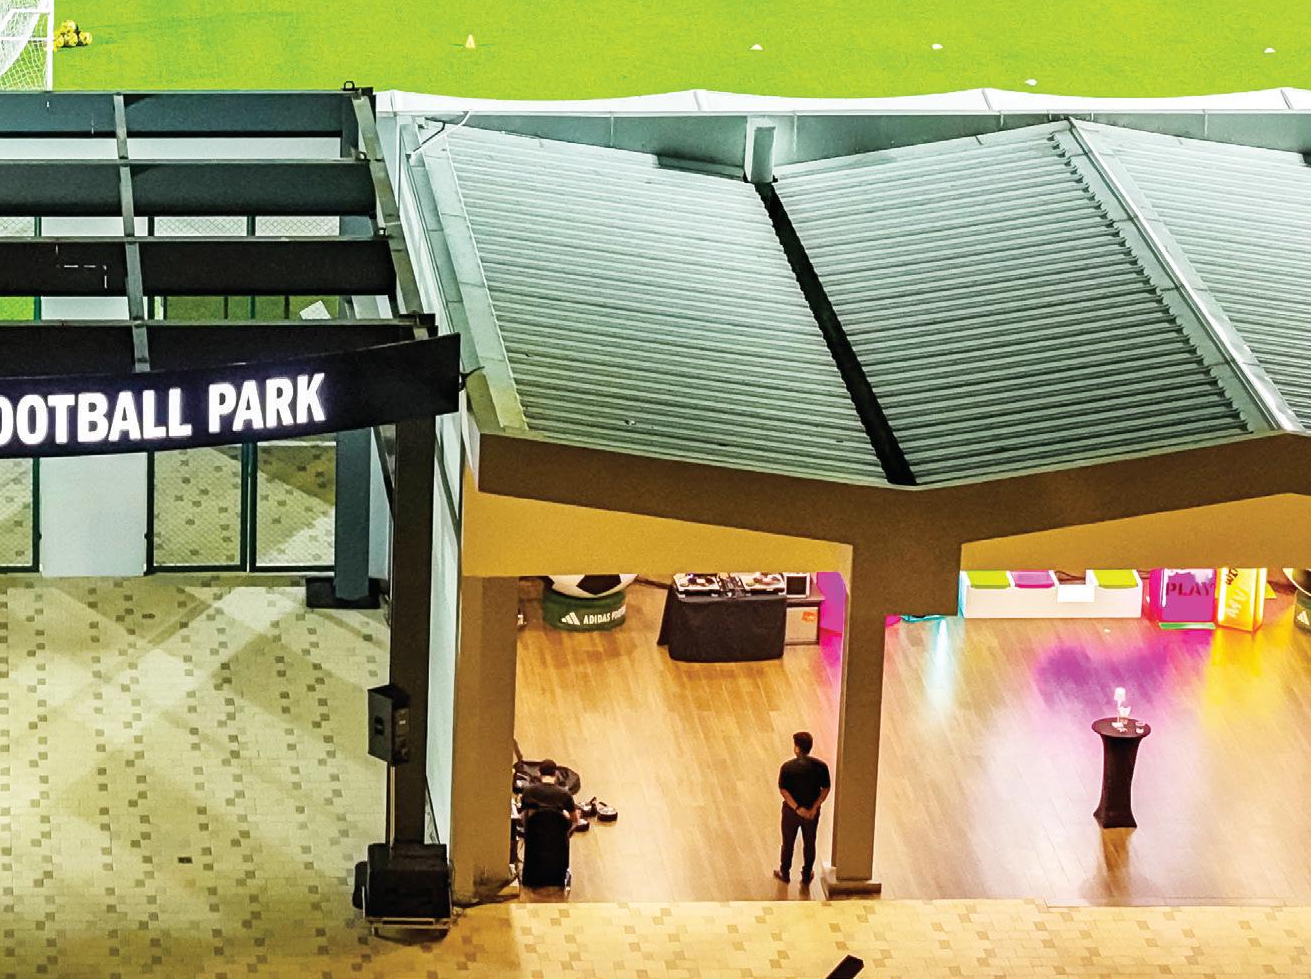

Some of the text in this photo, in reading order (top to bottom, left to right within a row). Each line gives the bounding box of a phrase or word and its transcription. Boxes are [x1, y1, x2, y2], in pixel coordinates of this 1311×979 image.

[208, 372, 326, 434] PARK
[1165, 582, 1213, 596] PLAY
[583, 612, 611, 625] ADIDAS
